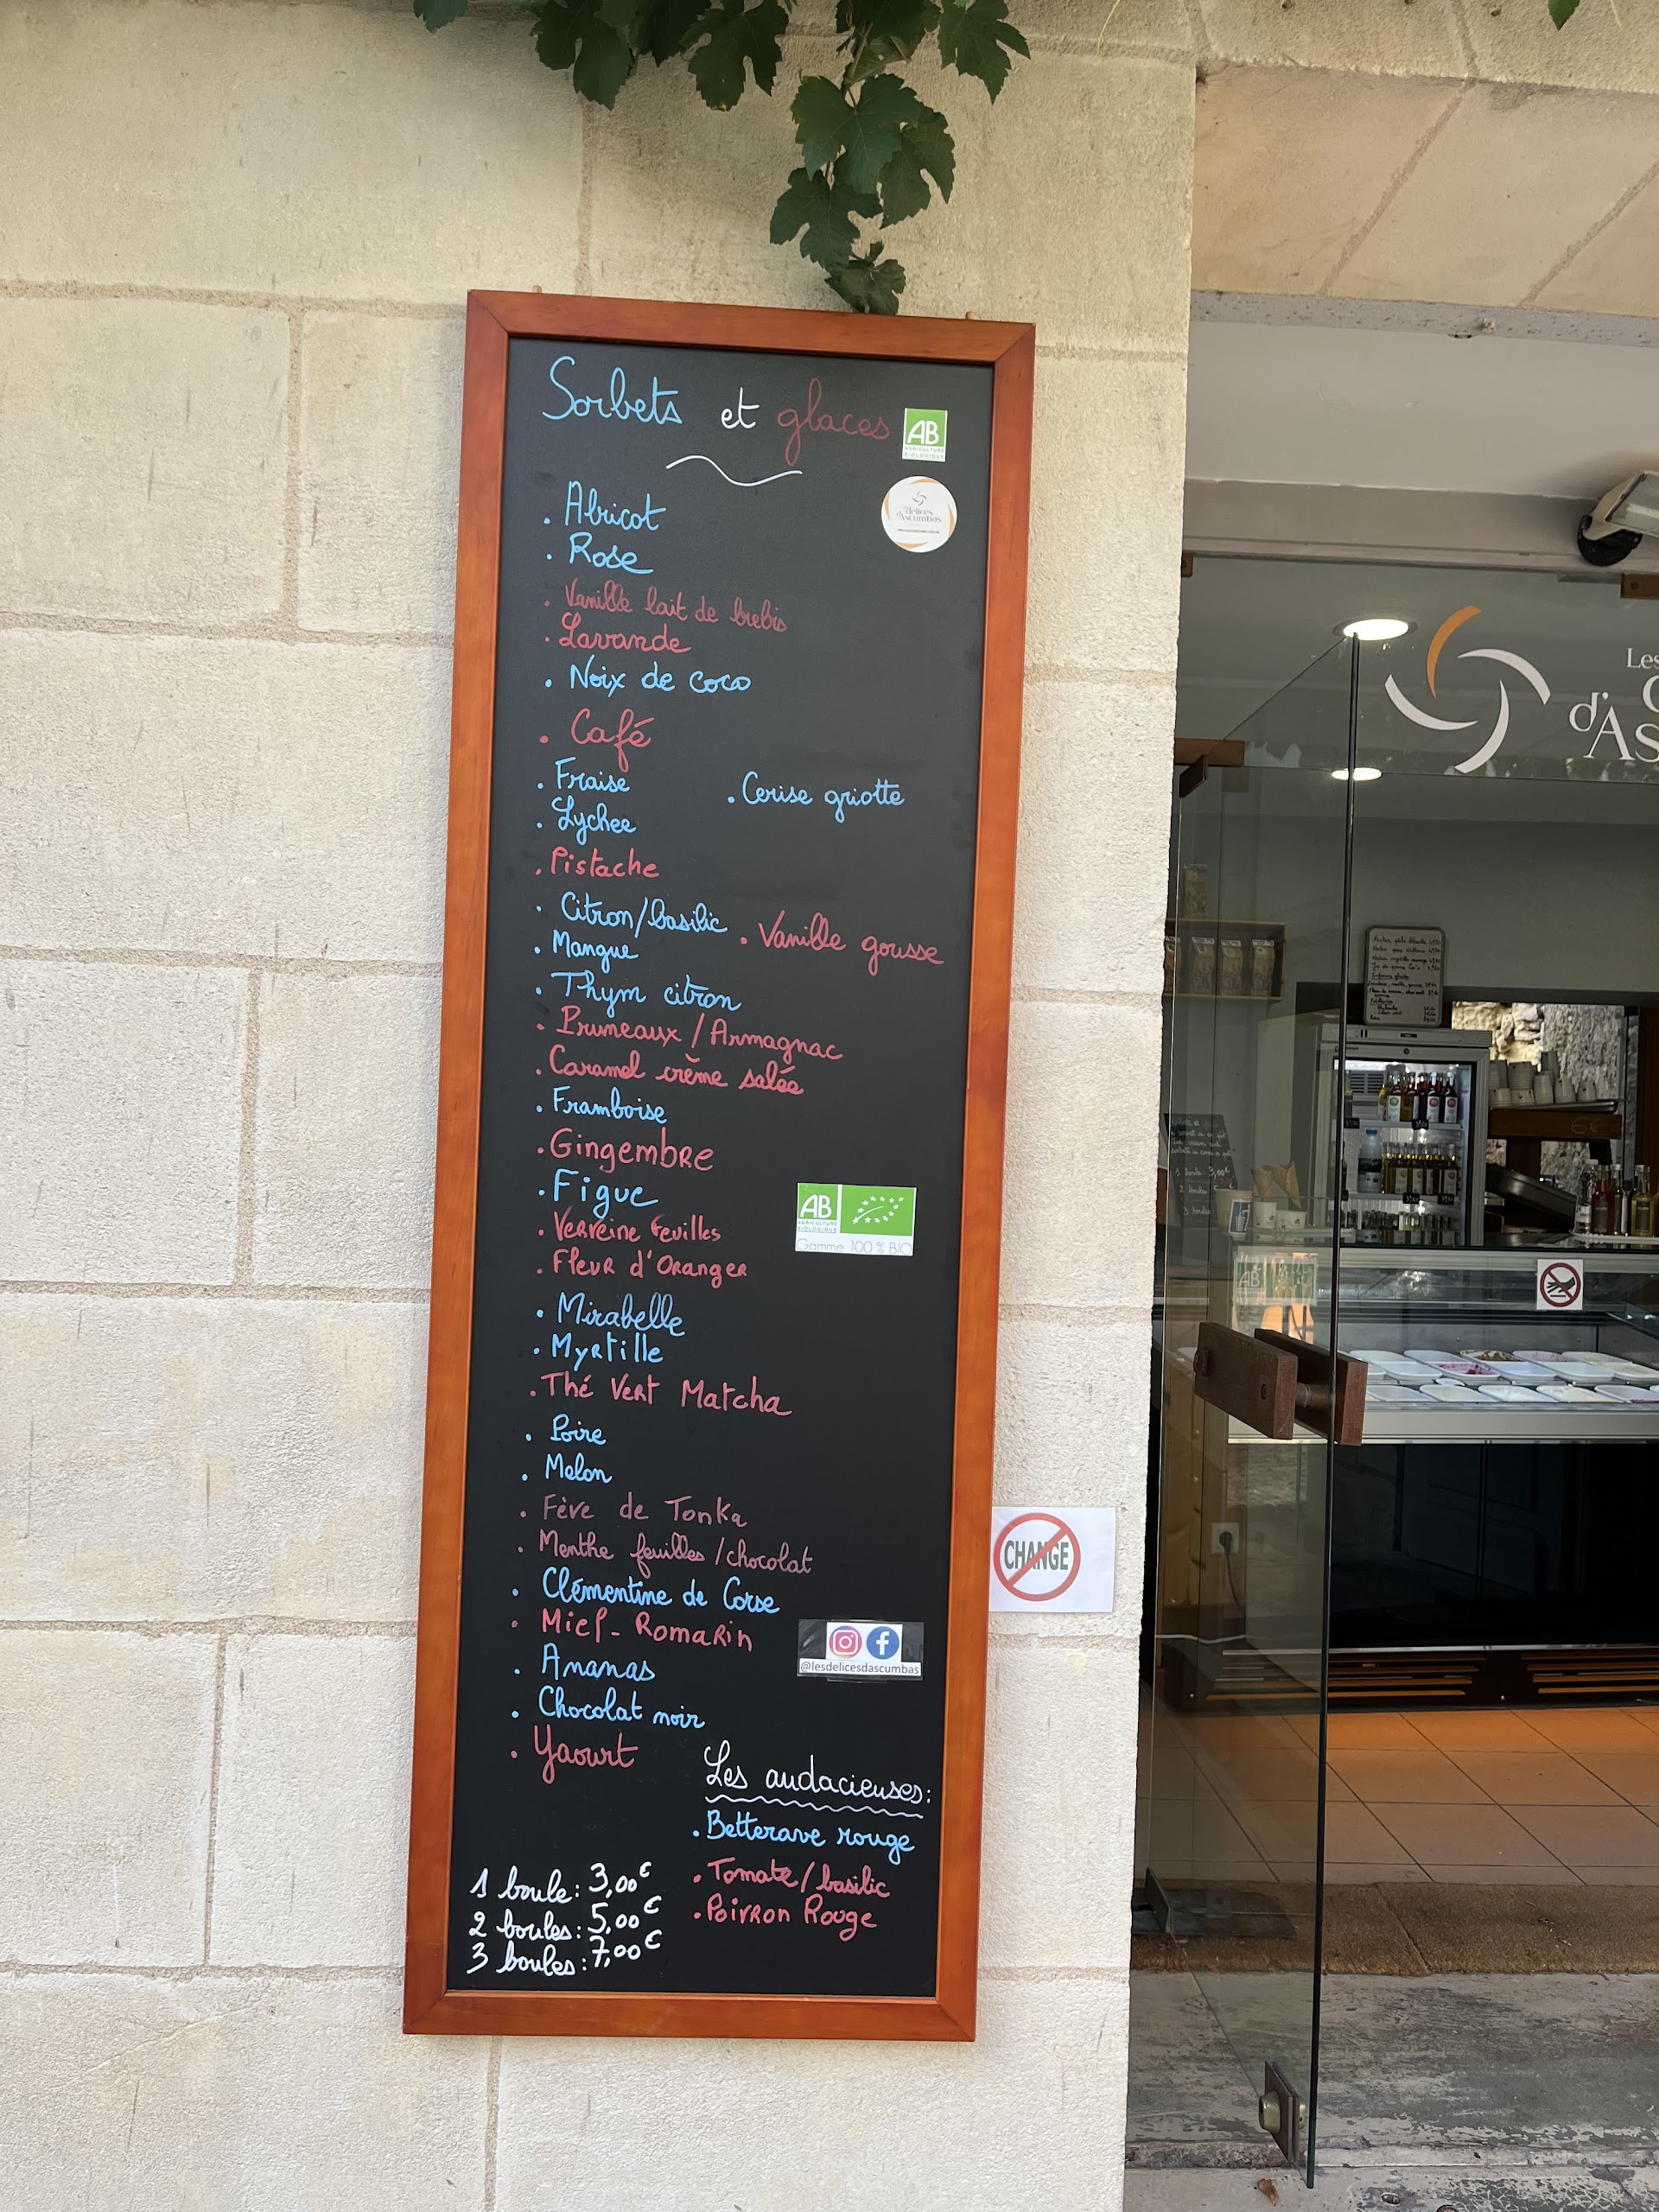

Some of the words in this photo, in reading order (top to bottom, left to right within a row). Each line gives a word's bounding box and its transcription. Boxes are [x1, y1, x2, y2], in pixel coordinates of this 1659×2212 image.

[543, 356, 683, 424] Sorbets
[721, 387, 760, 429] et
[778, 379, 889, 465] glaces
[907, 420, 939, 445] AB
[565, 480, 666, 531] Abricot
[569, 531, 653, 574] Rose
[566, 578, 632, 613] Vanille
[645, 588, 687, 620] lait
[695, 595, 718, 622] de
[730, 598, 786, 631] brebis
[559, 612, 691, 653] Lavande
[570, 654, 626, 697] Noix
[641, 661, 675, 691] de
[690, 671, 751, 693] coco
[571, 709, 654, 772] Café
[555, 757, 630, 792] Fraise
[742, 772, 813, 804] Cerise
[824, 779, 905, 823] griotte
[551, 795, 636, 845] Lychee
[551, 847, 659, 878] Pistache
[553, 930, 639, 974] Mangue
[759, 910, 846, 950] Vanille
[861, 936, 944, 976] gousse
[551, 969, 646, 1018] Thym
[664, 975, 741, 1011] citron
[556, 1005, 682, 1047] Pruneaux
[550, 1045, 645, 1079] Caramel
[655, 1050, 728, 1087] crème
[739, 1060, 804, 1095] salée
[553, 1086, 667, 1124] Framboise
[550, 1127, 714, 1173] Gingembre
[554, 1168, 658, 1218] Figue
[799, 1194, 832, 1219] AB
[554, 1205, 640, 1242] Verveine
[553, 1247, 615, 1275] Fleur
[797, 1237, 844, 1253] Gamme
[851, 1240, 873, 1254] 100
[876, 1242, 885, 1255] %
[888, 1242, 912, 1255] BIO
[558, 1292, 685, 1337] Mirabelle
[552, 1332, 663, 1371] Myrtille
[541, 1370, 594, 1398] Thé
[682, 1376, 792, 1415] Matcha
[550, 1414, 606, 1445] Poire
[545, 1452, 612, 1483] Melon
[544, 1494, 594, 1519] Fève
[620, 1491, 649, 1519] de
[664, 1496, 747, 1527] Tonka
[540, 1529, 614, 1560] Menthe
[630, 1532, 705, 1579] feuilles
[1004, 1540, 1069, 1571] CHANGE
[543, 1567, 672, 1605] Clémentine
[683, 1579, 708, 1606] de
[723, 1576, 780, 1613] Corse
[636, 1611, 752, 1651] Romarin
[542, 1643, 655, 1681] Ananas
[800, 1661, 919, 1675] @lesdelicesdascumbas
[539, 1685, 642, 1721] Chocolat
[652, 1706, 705, 1728] noir
[535, 1724, 639, 1783] Yaourt
[704, 1740, 747, 1789] Les
[707, 1809, 826, 1847] Betterave
[836, 1827, 915, 1865] rouge
[470, 1868, 488, 1898] 1
[469, 1911, 486, 1937] 2
[707, 1893, 790, 1923] Poivron
[804, 1893, 877, 1942] Rouge
[467, 1942, 488, 1974] 3
